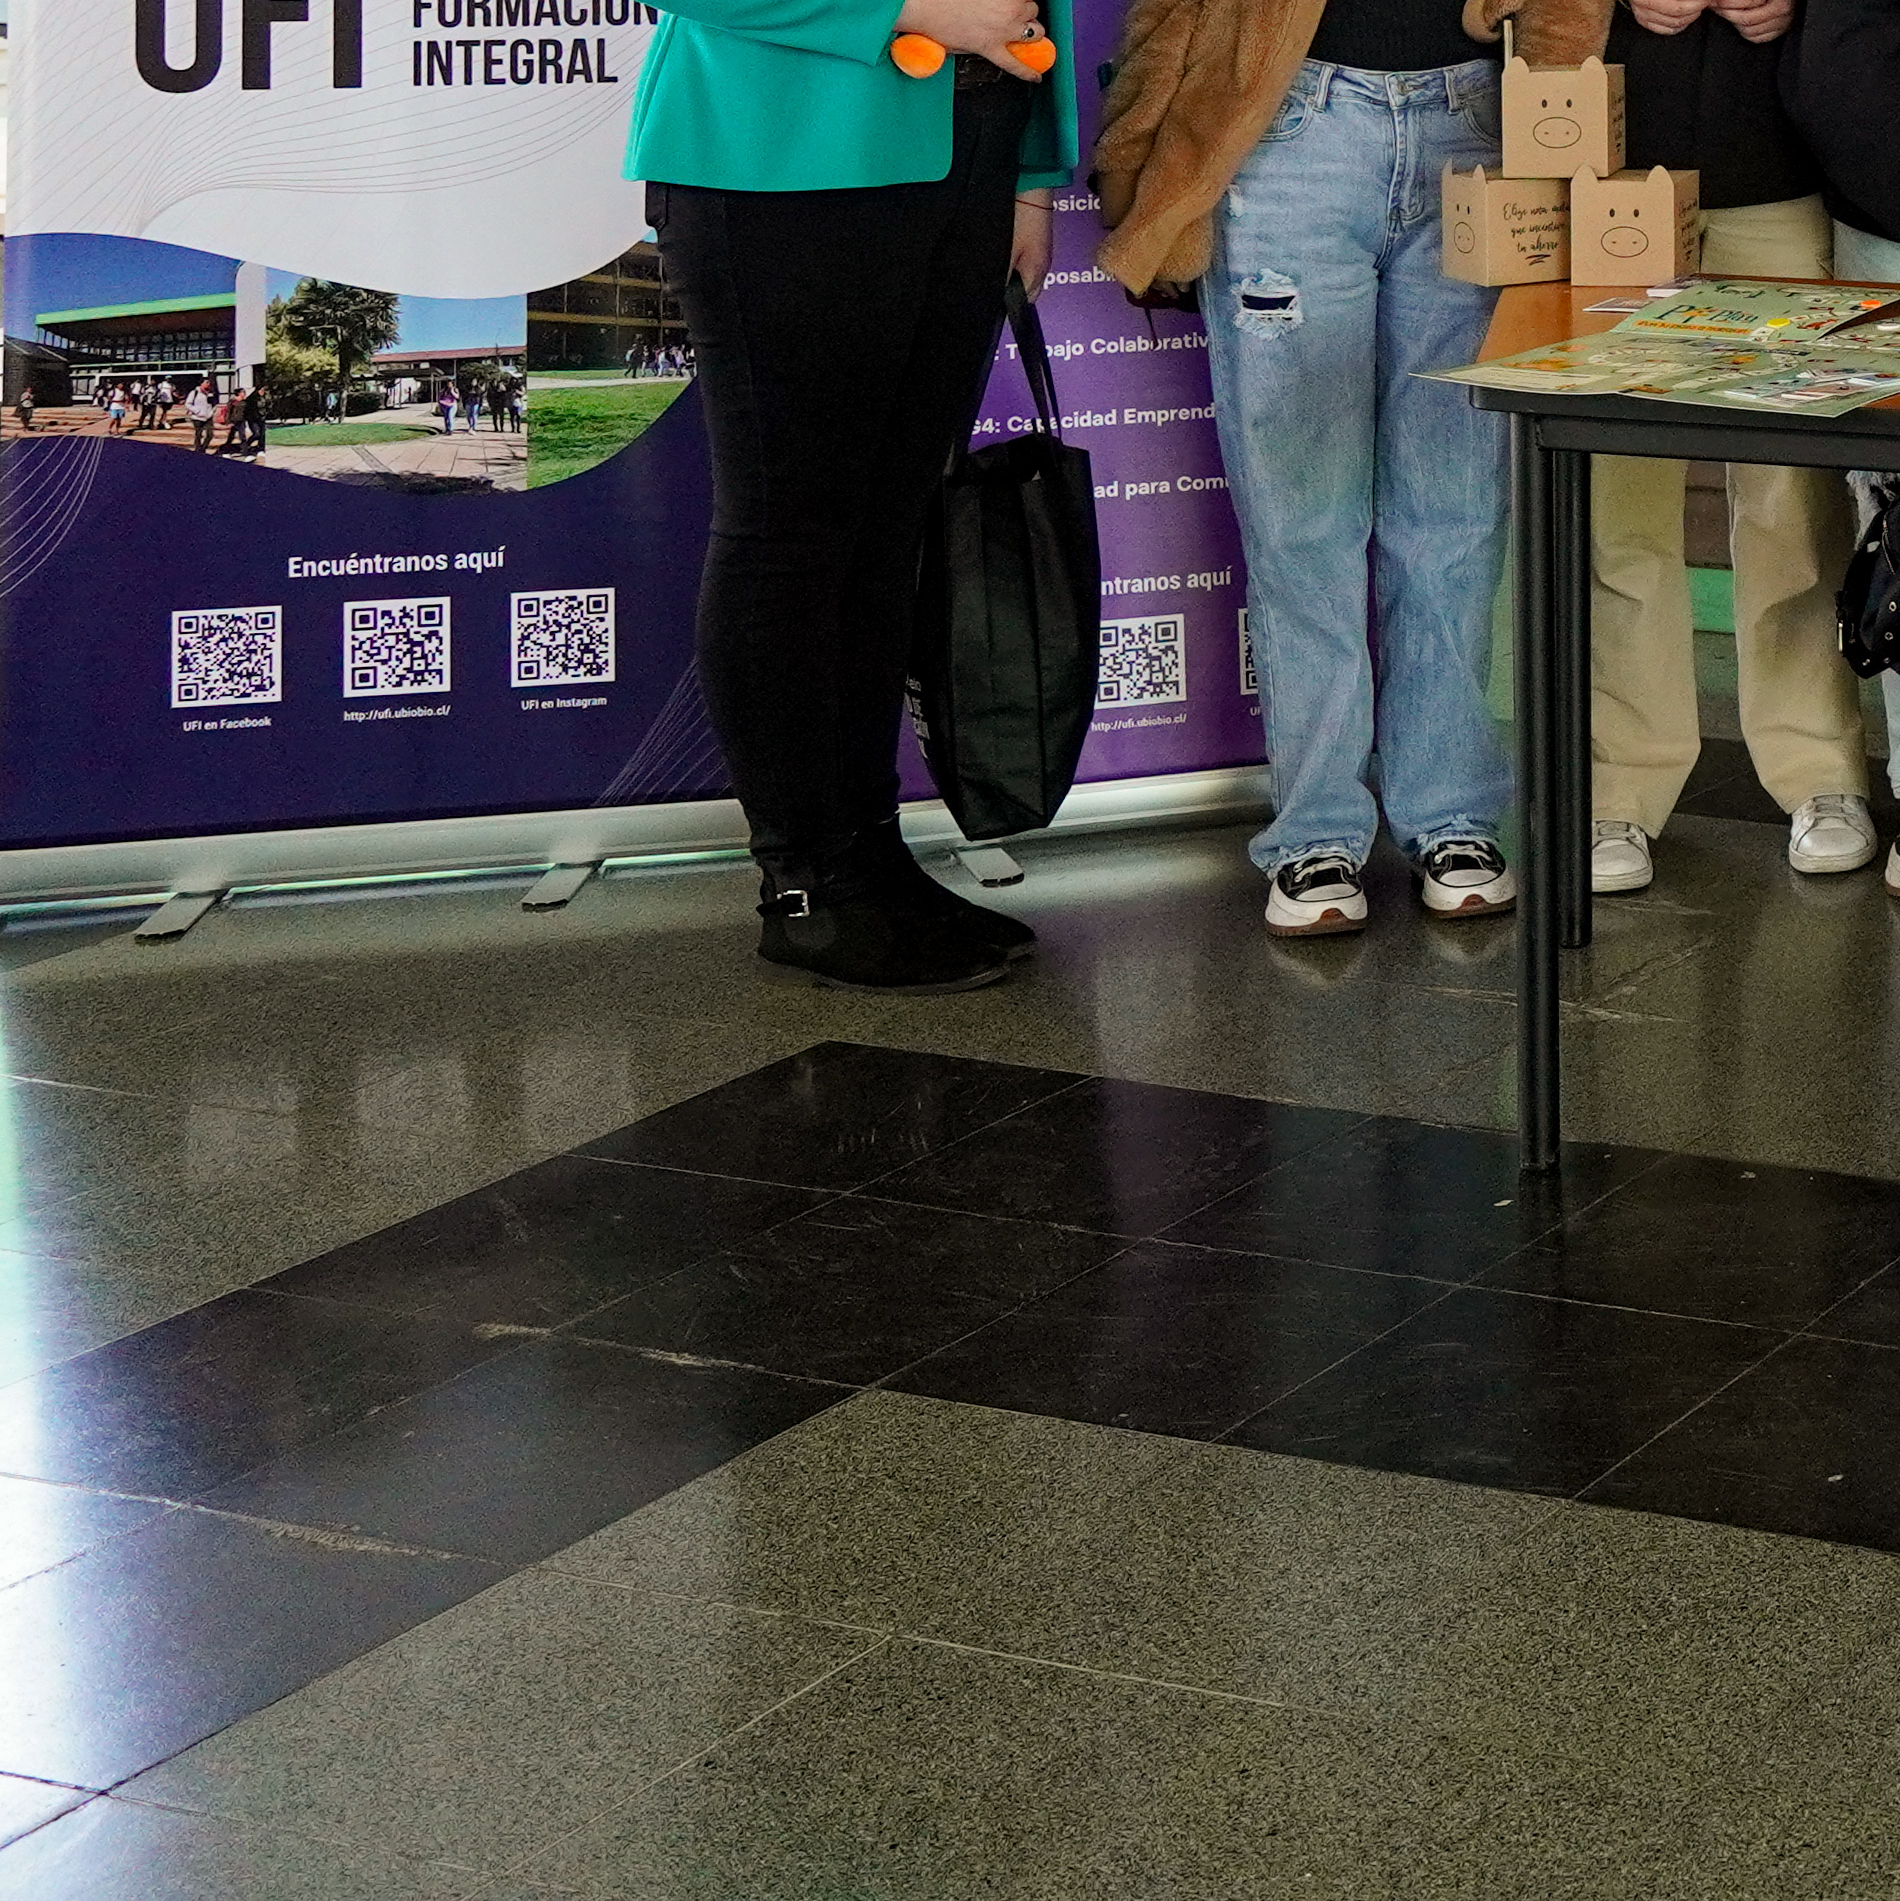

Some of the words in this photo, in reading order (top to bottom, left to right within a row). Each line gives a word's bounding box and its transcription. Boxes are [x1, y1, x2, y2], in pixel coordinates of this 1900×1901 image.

[413, 38, 618, 86] INTEGRAL
[1124, 403, 1216, 426] Emprend
[1126, 480, 1170, 500] para
[288, 550, 448, 580] Encuéntranos
[454, 546, 506, 575] aquí
[1101, 575, 1180, 596] ntranos
[1186, 565, 1232, 591] aquí
[343, 704, 451, 723] http://ufi.ubiobio.cl/
[521, 700, 538, 710] UFI
[541, 700, 554, 709] en
[556, 695, 607, 711] Instagram
[183, 721, 201, 731] UFI
[204, 720, 218, 730] en
[220, 716, 272, 729] Facebook
